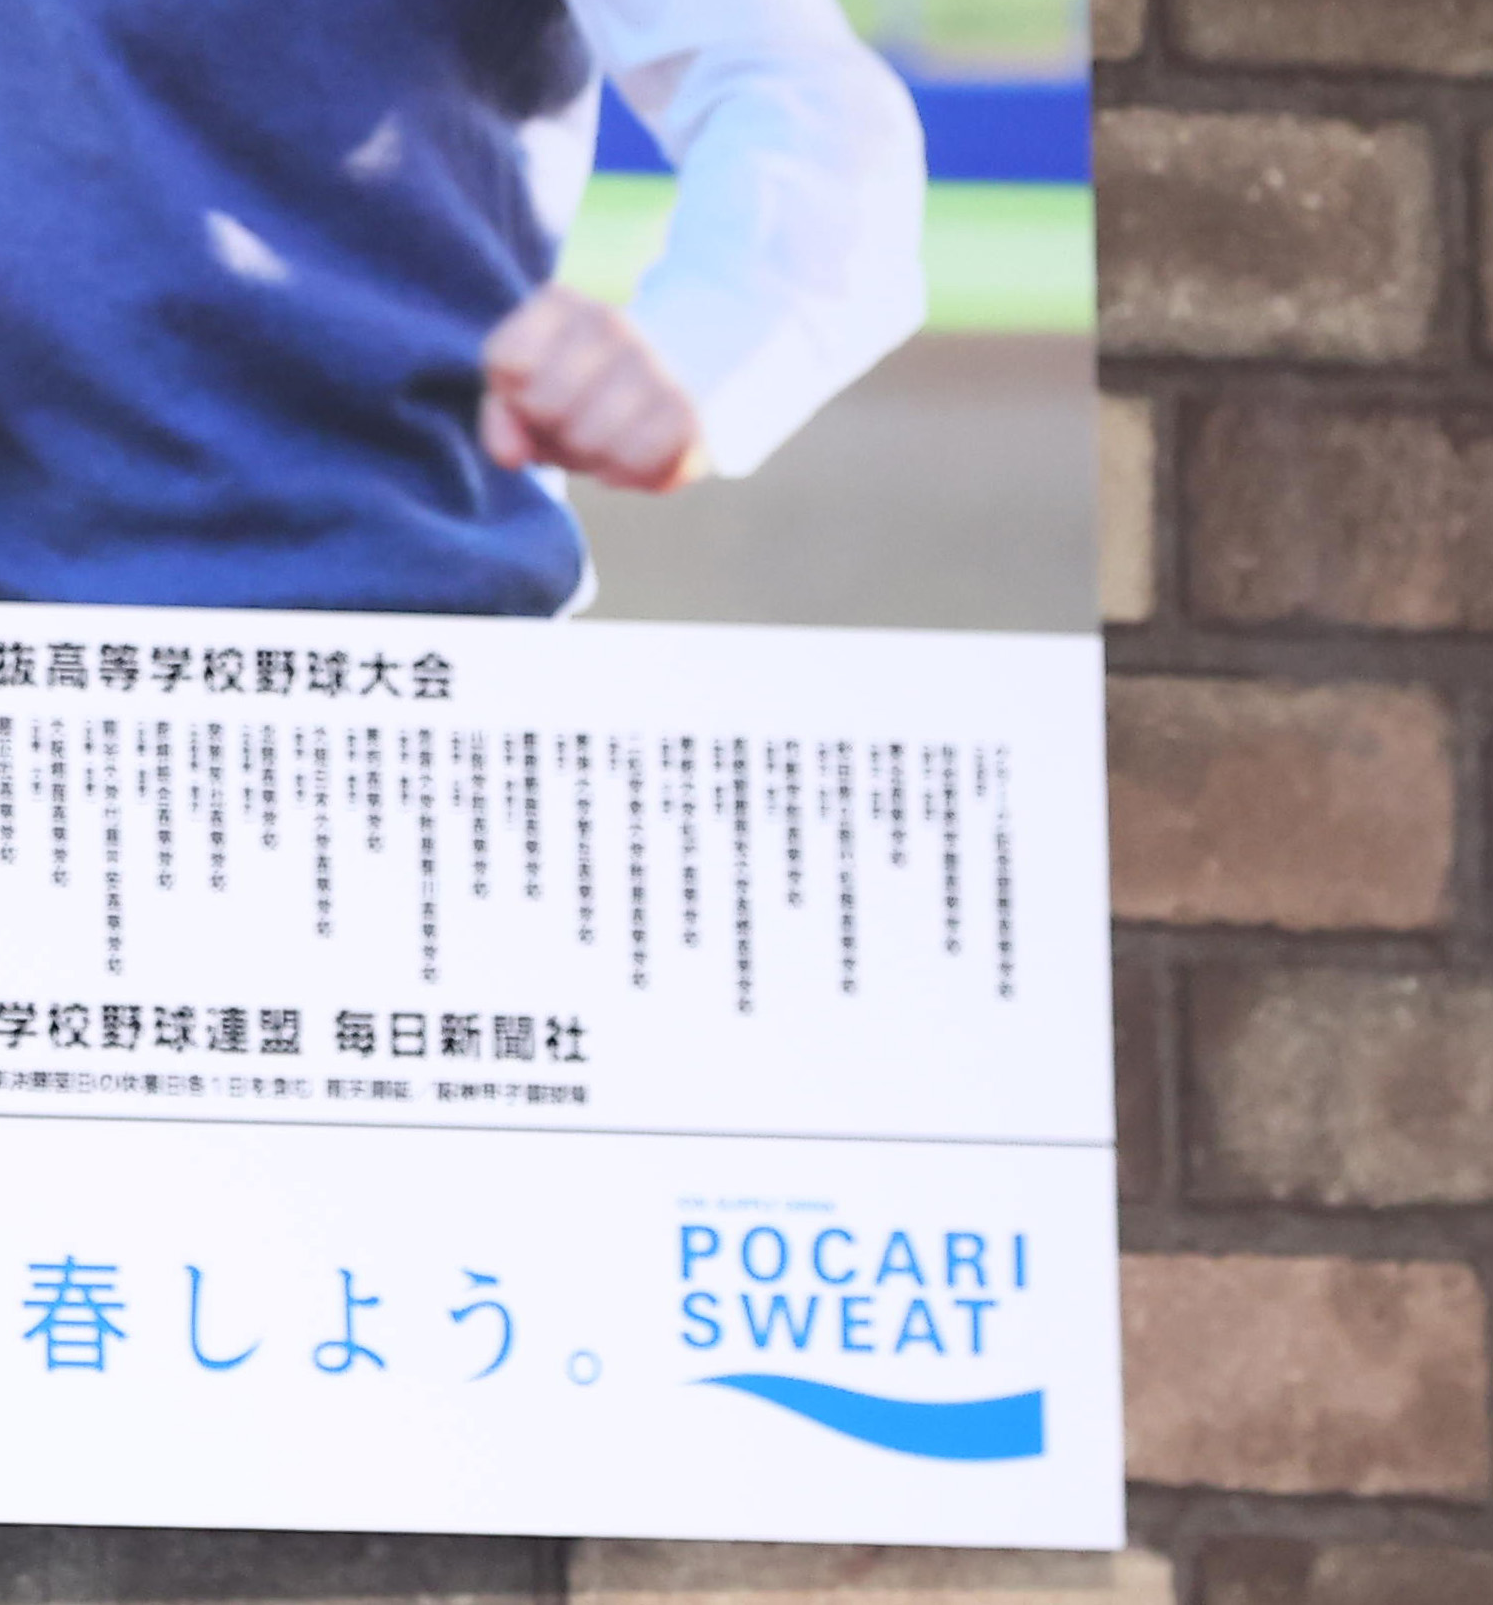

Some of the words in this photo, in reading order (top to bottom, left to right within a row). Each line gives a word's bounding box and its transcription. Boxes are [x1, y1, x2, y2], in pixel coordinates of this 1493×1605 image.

[333, 1007, 591, 1065] 毎日新聞社
[678, 1222, 1030, 1291] POCARI
[679, 1287, 1000, 1358] SWEAT
